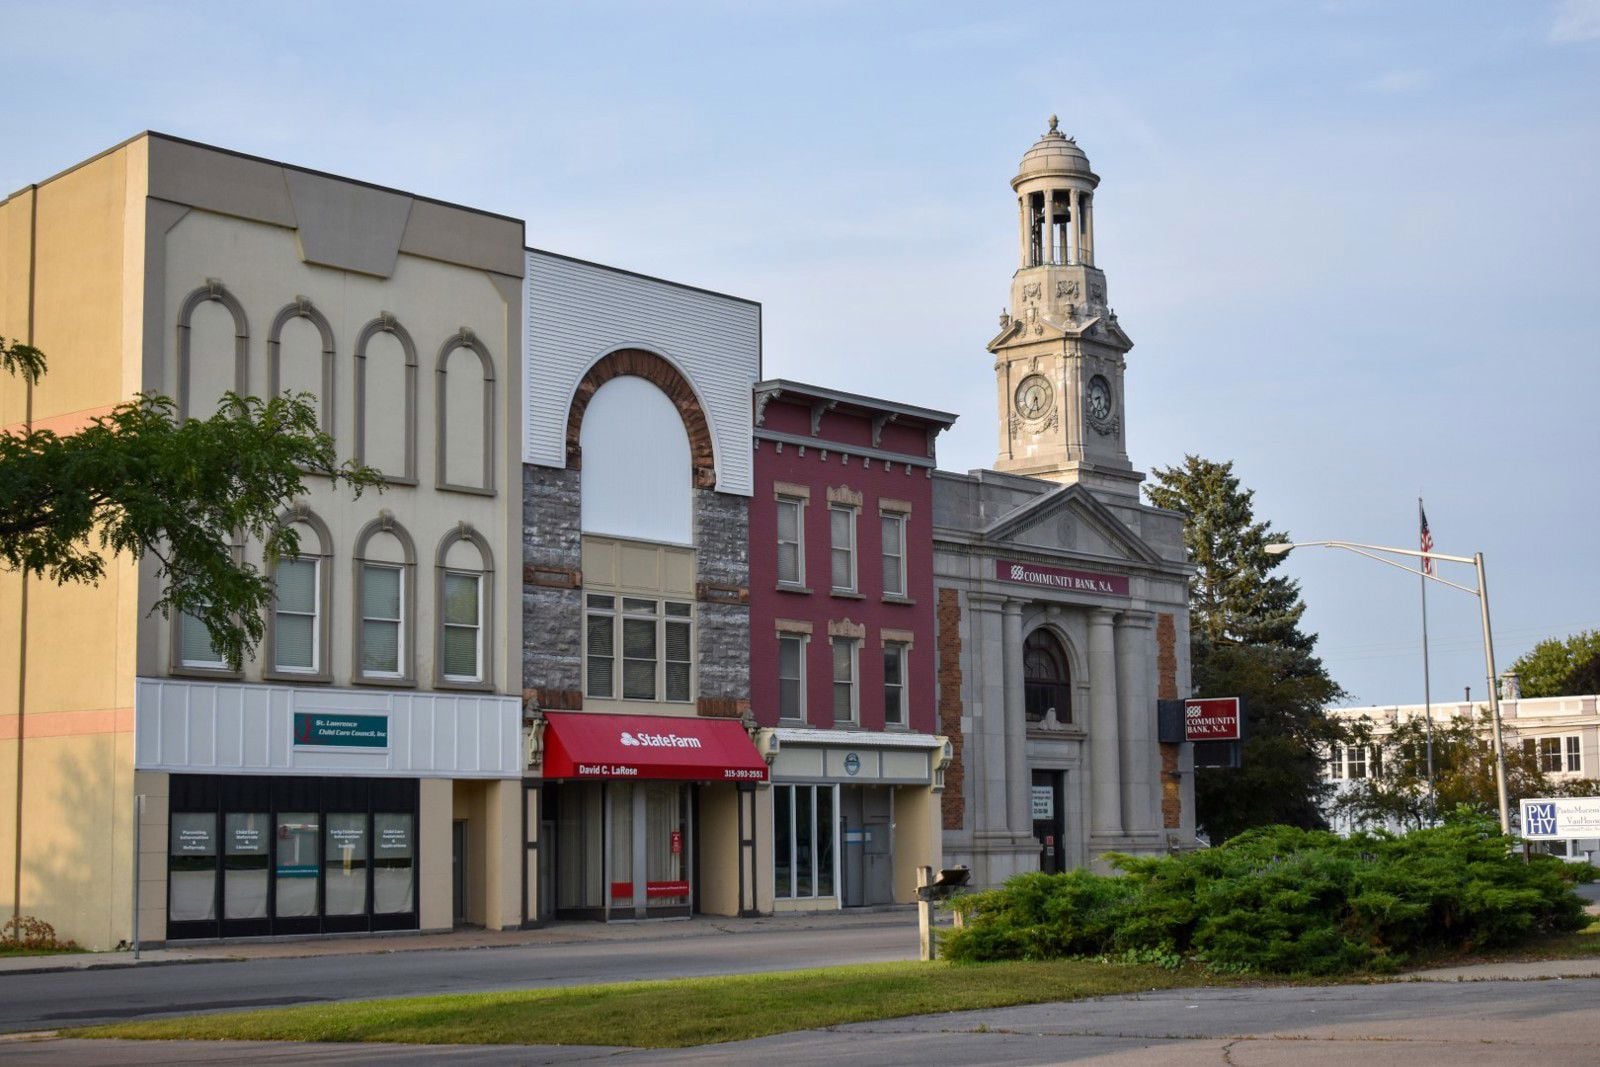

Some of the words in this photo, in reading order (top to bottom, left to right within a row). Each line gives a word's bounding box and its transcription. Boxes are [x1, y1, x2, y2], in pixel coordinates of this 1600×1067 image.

[1024, 571, 1072, 588] COMMUNITY
[1075, 578, 1097, 592] BANK,
[326, 720, 358, 728] Lawrence
[1187, 717, 1236, 726] COMMUNITY
[319, 728, 336, 736] Child
[336, 729, 351, 737] Care
[1212, 725, 1228, 733] N.A.
[579, 765, 600, 775] David
[601, 766, 610, 775] C.
[611, 766, 638, 776] LaRose
